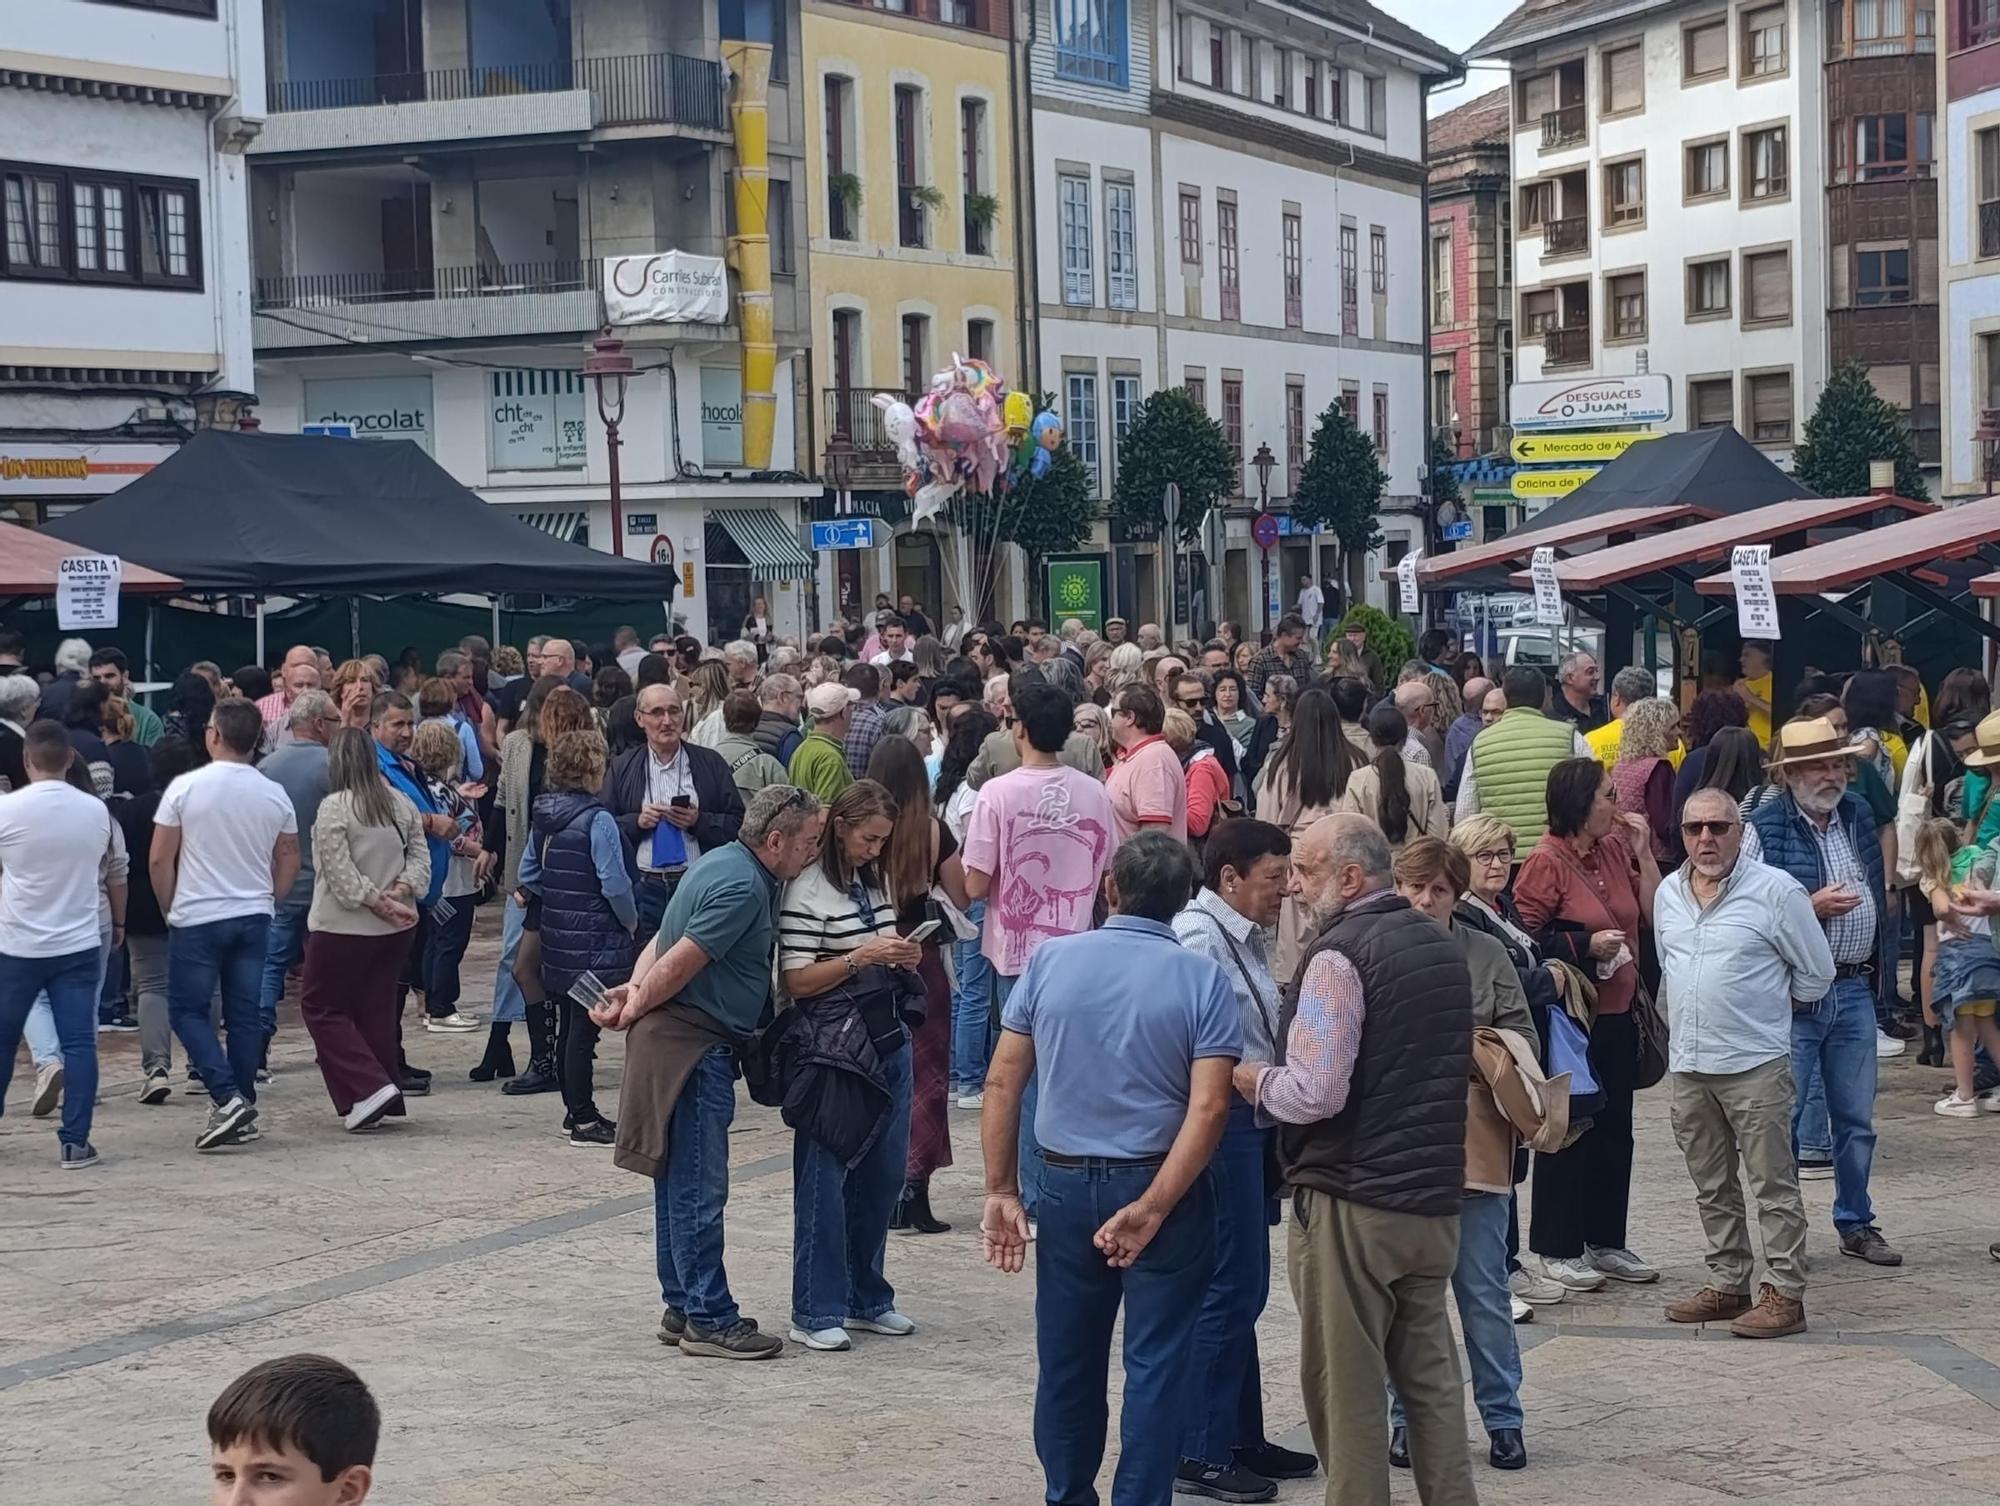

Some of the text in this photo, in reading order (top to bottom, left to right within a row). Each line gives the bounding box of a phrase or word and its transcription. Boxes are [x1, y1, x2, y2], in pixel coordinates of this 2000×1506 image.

[1566, 389, 1641, 403] DESGUACES
[495, 402, 524, 423] cht
[1543, 439, 1630, 453] Mercado de Ab
[1516, 477, 1588, 489] Oficina de Tu
[1732, 548, 1768, 566] CASETA 12
[61, 559, 118, 573] CASETA 1
